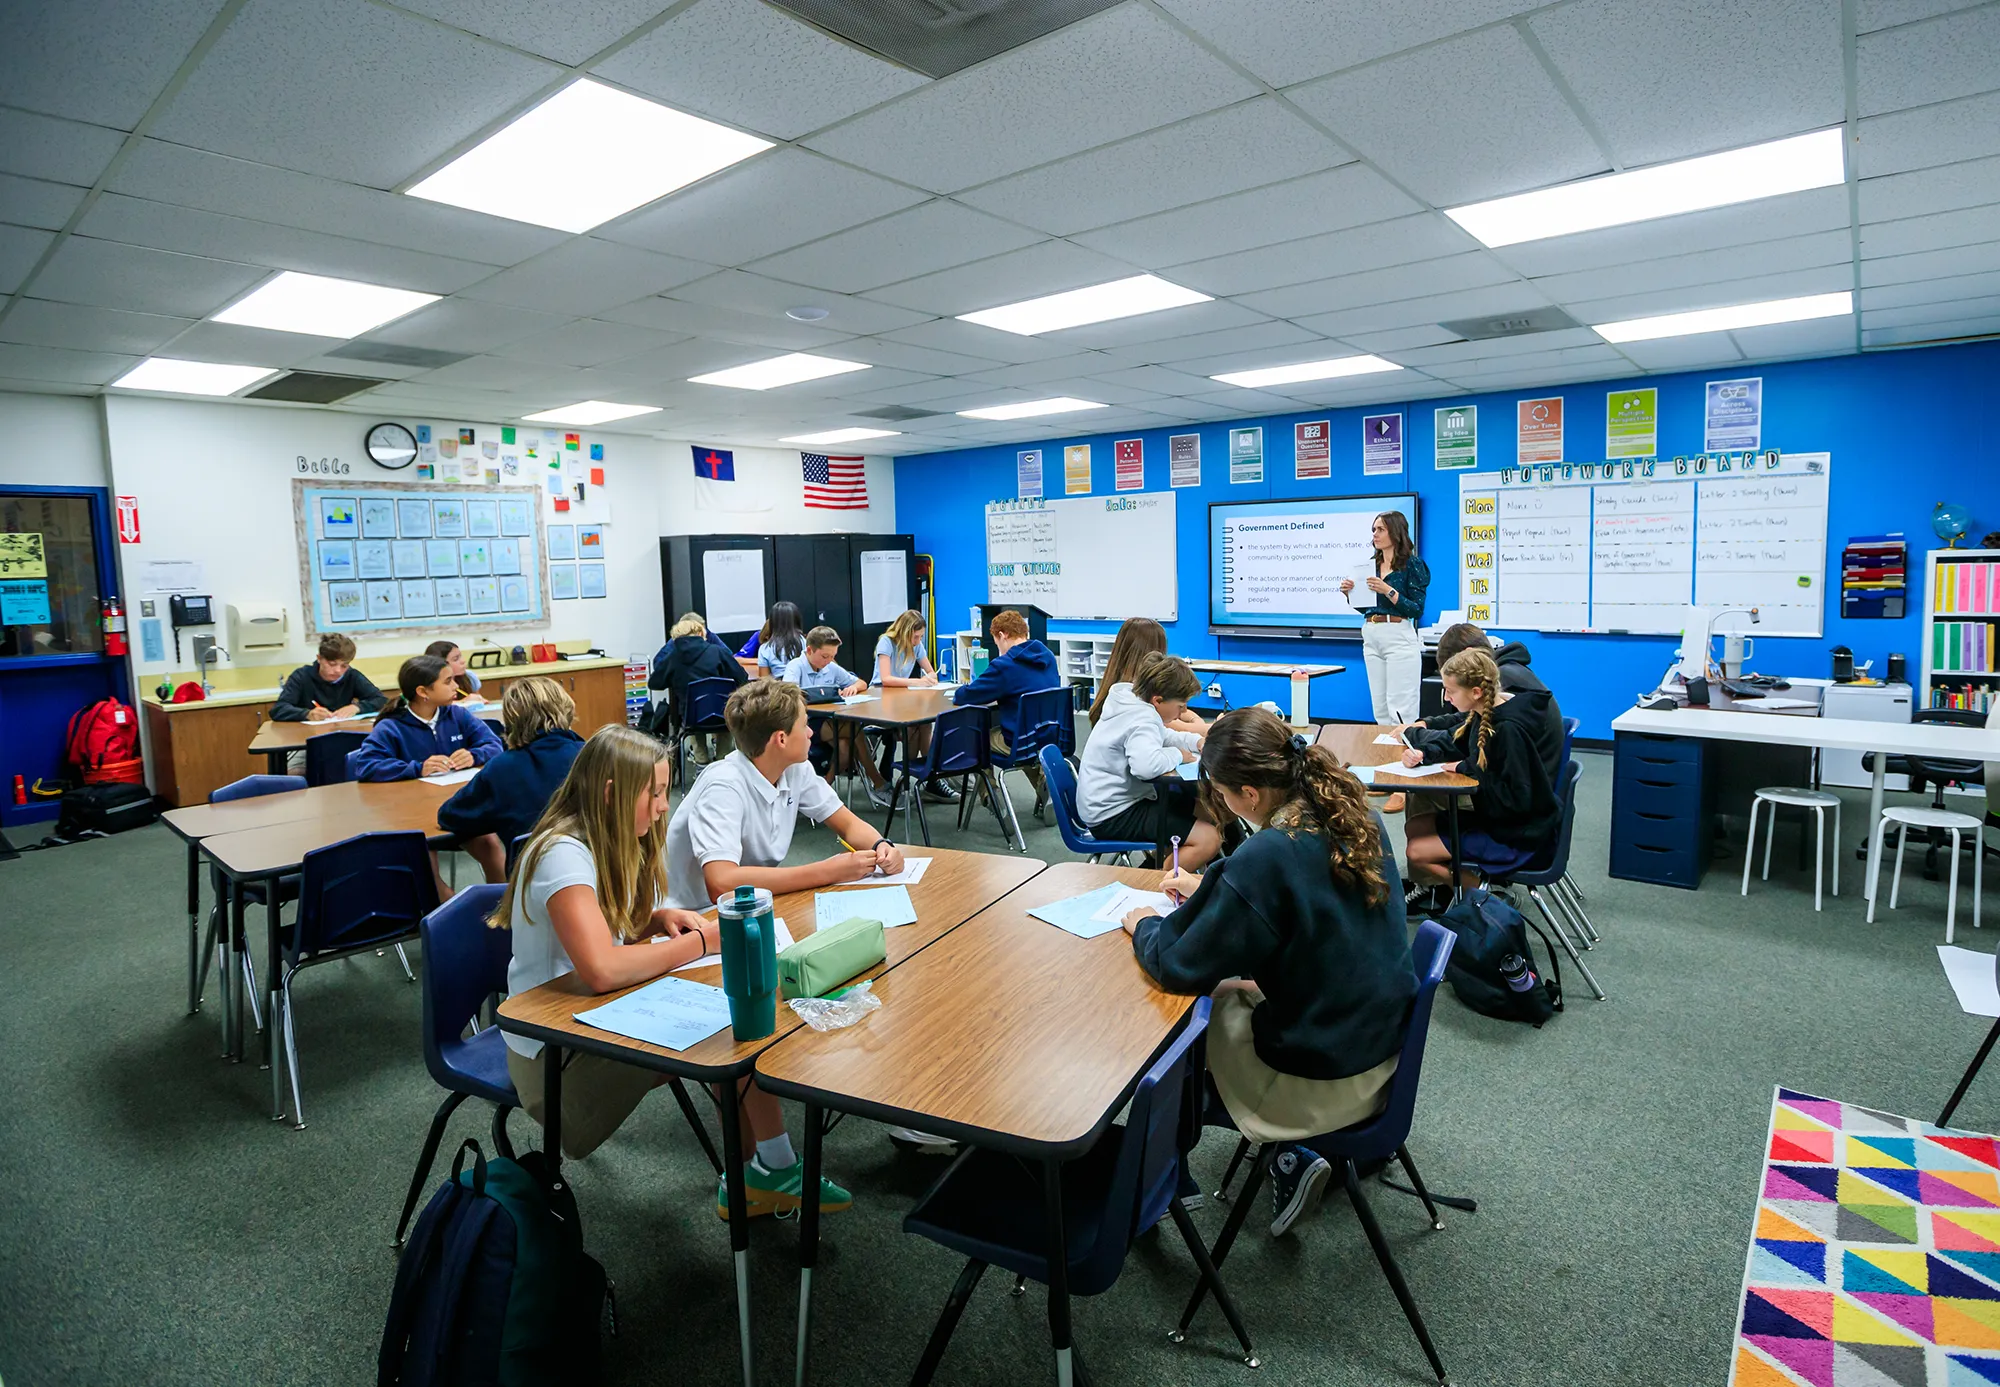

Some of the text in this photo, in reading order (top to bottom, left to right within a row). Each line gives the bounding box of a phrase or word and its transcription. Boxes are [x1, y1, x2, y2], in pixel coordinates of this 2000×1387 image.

[1713, 406, 1753, 415] Disciplines
[1610, 416, 1653, 424] Perspectives
[1501, 451, 1779, 484] HOMEWORK BOARD
[1466, 499, 1493, 514] Mon
[1238, 521, 1325, 532] Government Defined
[1464, 526, 1496, 541] Tues
[1260, 543, 1282, 551] system
[1284, 543, 1292, 551] by
[1466, 553, 1492, 568] Wed
[989, 563, 1015, 576] TESTS
[1471, 579, 1488, 594] Th
[1468, 605, 1489, 620] Fri
